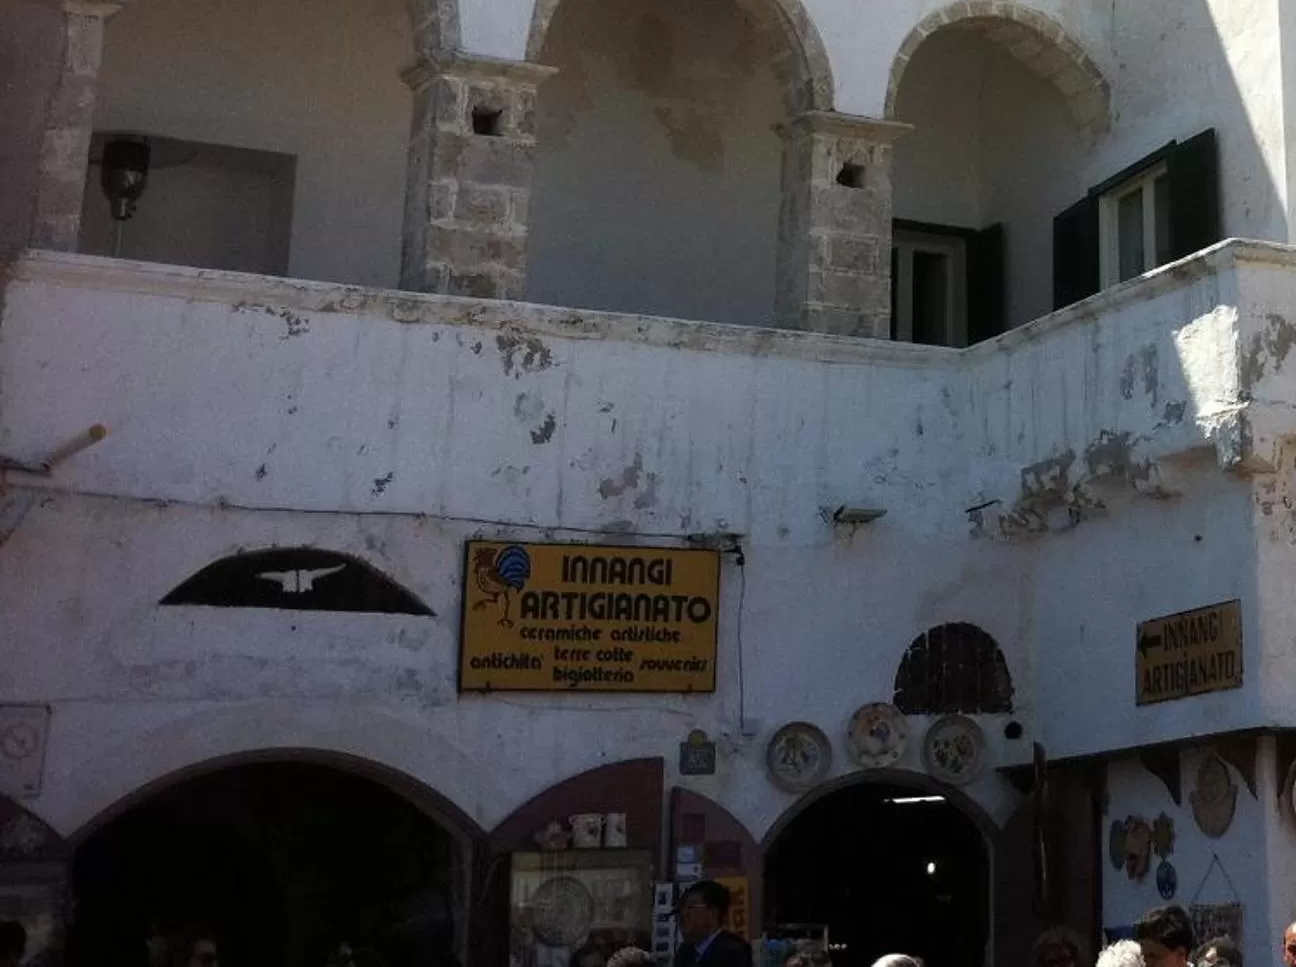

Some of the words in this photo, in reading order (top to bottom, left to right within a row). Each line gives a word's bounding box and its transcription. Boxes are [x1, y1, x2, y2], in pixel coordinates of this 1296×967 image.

[562, 555, 673, 585] INNANGI
[519, 591, 712, 624] ARTIGIANATO
[519, 624, 603, 642] ceramiche
[609, 626, 682, 643] artistiche
[553, 645, 592, 662] terre
[595, 647, 634, 663] cotte
[1143, 650, 1236, 694] ARTIGIANATO
